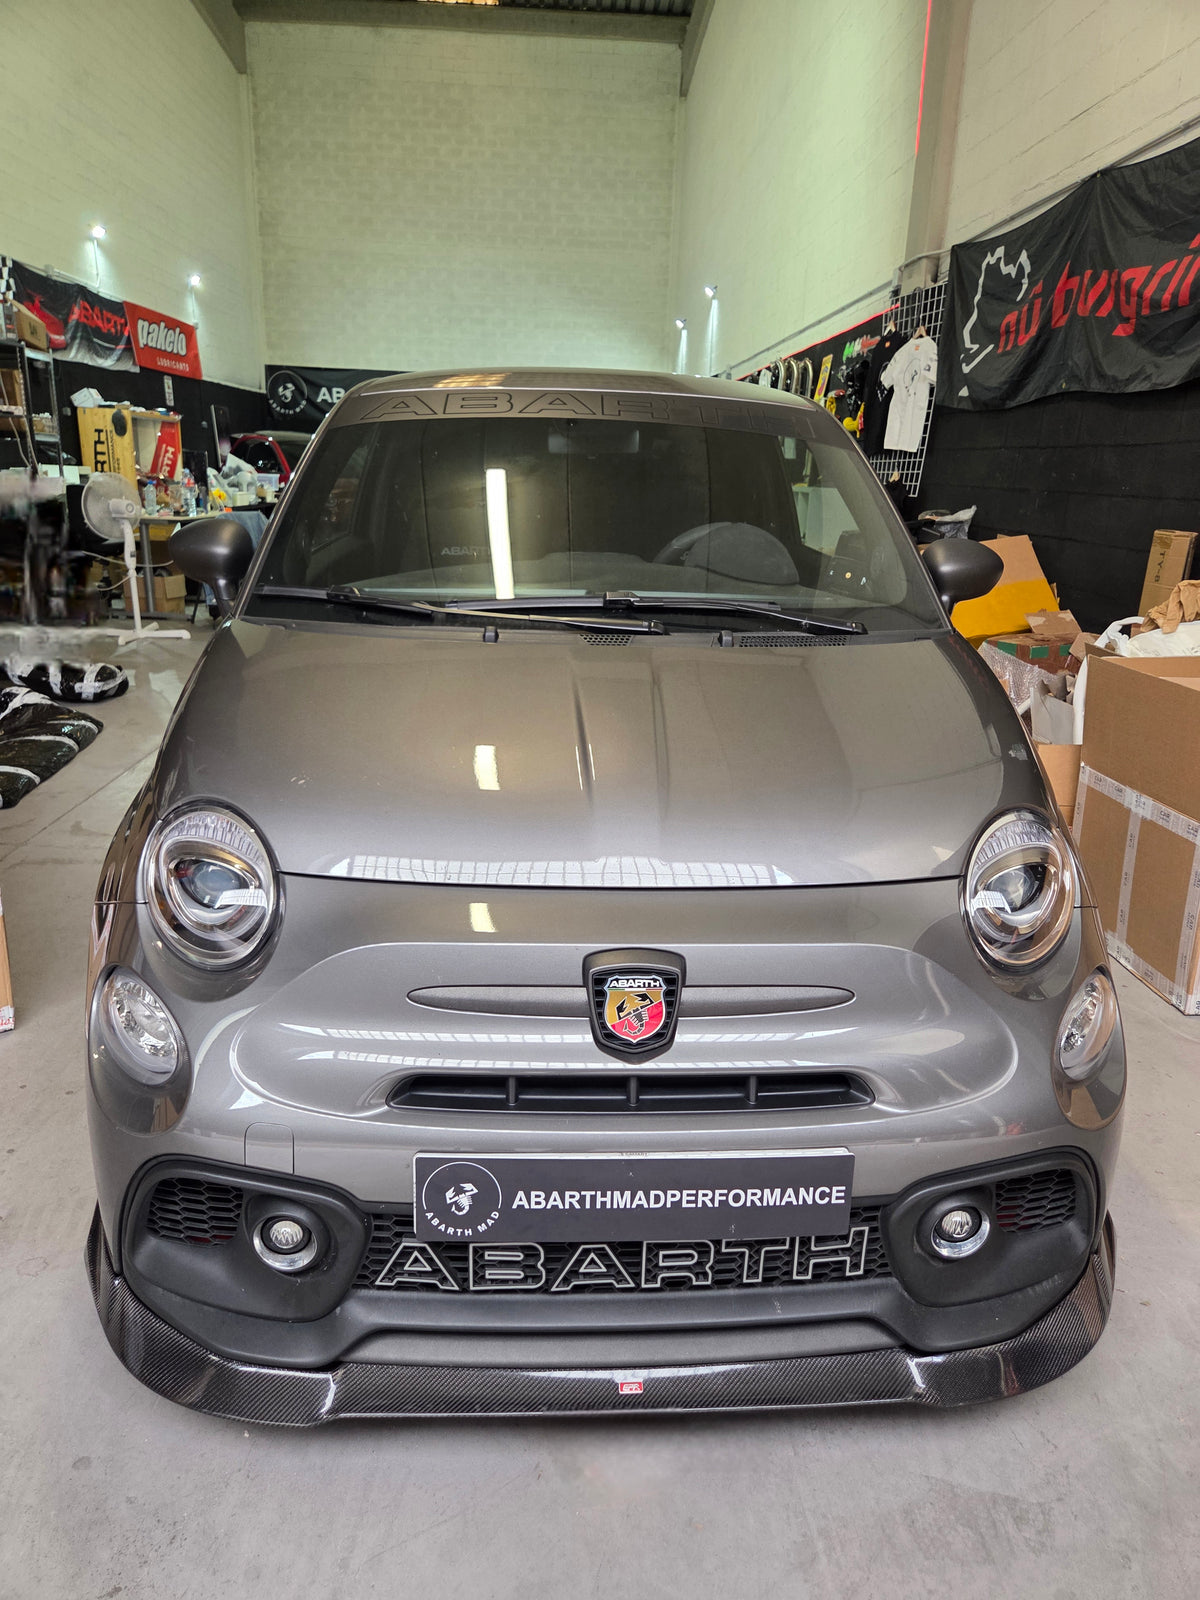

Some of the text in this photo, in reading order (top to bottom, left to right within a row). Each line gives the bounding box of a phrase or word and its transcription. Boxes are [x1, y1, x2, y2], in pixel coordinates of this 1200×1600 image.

[137, 318, 188, 357] pakelo
[156, 357, 190, 372] LUBRICANTS
[360, 392, 817, 440] ABARTH
[609, 979, 660, 988] ABARTH
[511, 1186, 846, 1209] ABARTHMADPERFORMANCE
[425, 1210, 500, 1237] ABARTH MAD
[374, 1226, 869, 1291] ABARTH
